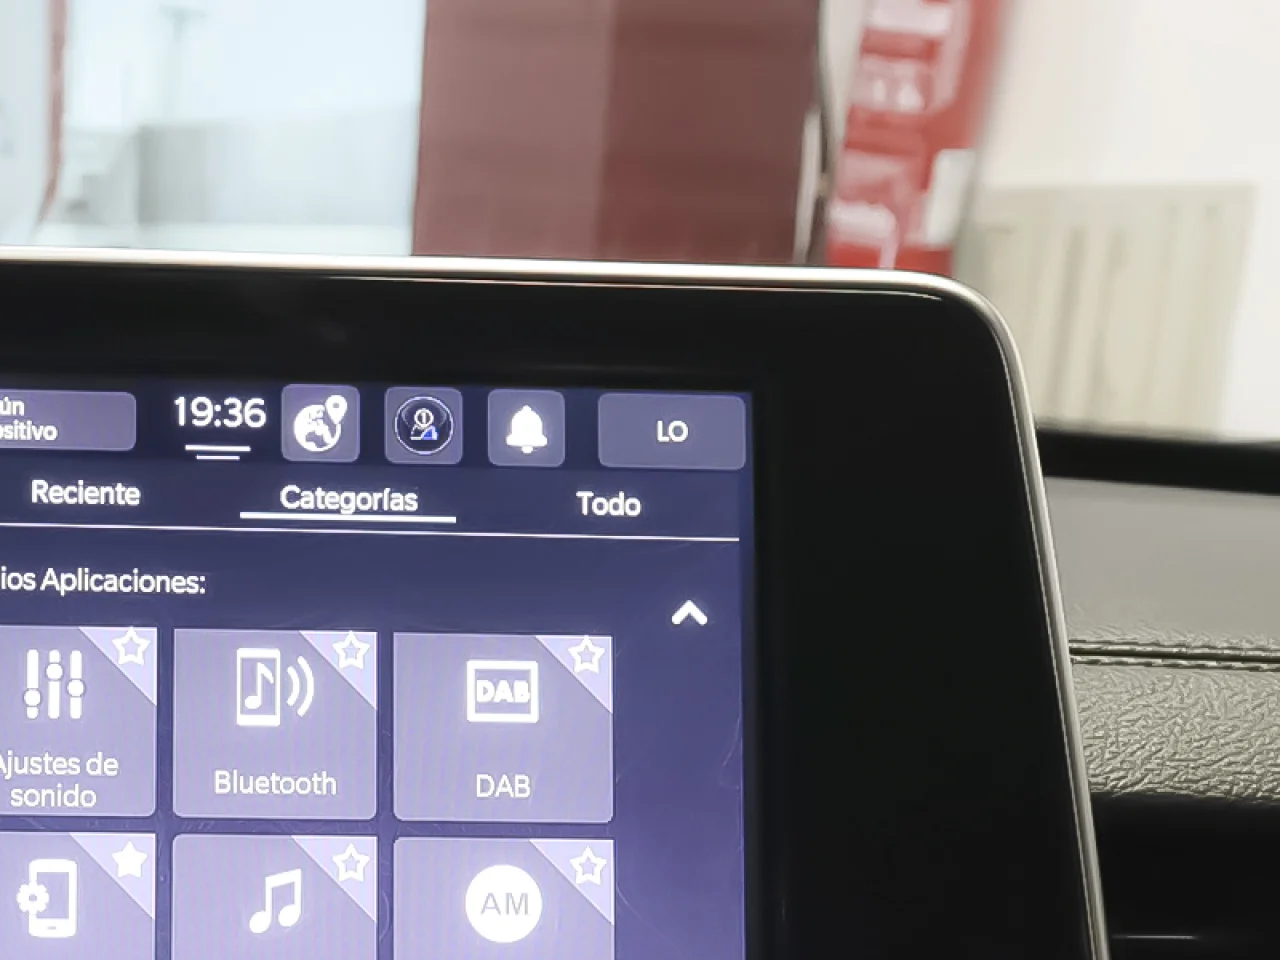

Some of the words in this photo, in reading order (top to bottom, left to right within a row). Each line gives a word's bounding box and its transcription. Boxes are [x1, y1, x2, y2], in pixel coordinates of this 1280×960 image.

[174, 396, 267, 428] 19:36
[656, 420, 689, 442] LO
[31, 479, 141, 506] Reciente
[279, 485, 419, 514] Categorías
[575, 491, 642, 516] Todo
[40, 567, 207, 596] Aplicaciones:
[476, 679, 530, 703] DAB
[85, 751, 120, 777] de
[10, 783, 97, 809] sonido
[214, 770, 338, 796] Bluetooth
[475, 774, 531, 798] DAB
[480, 891, 530, 916] AM
